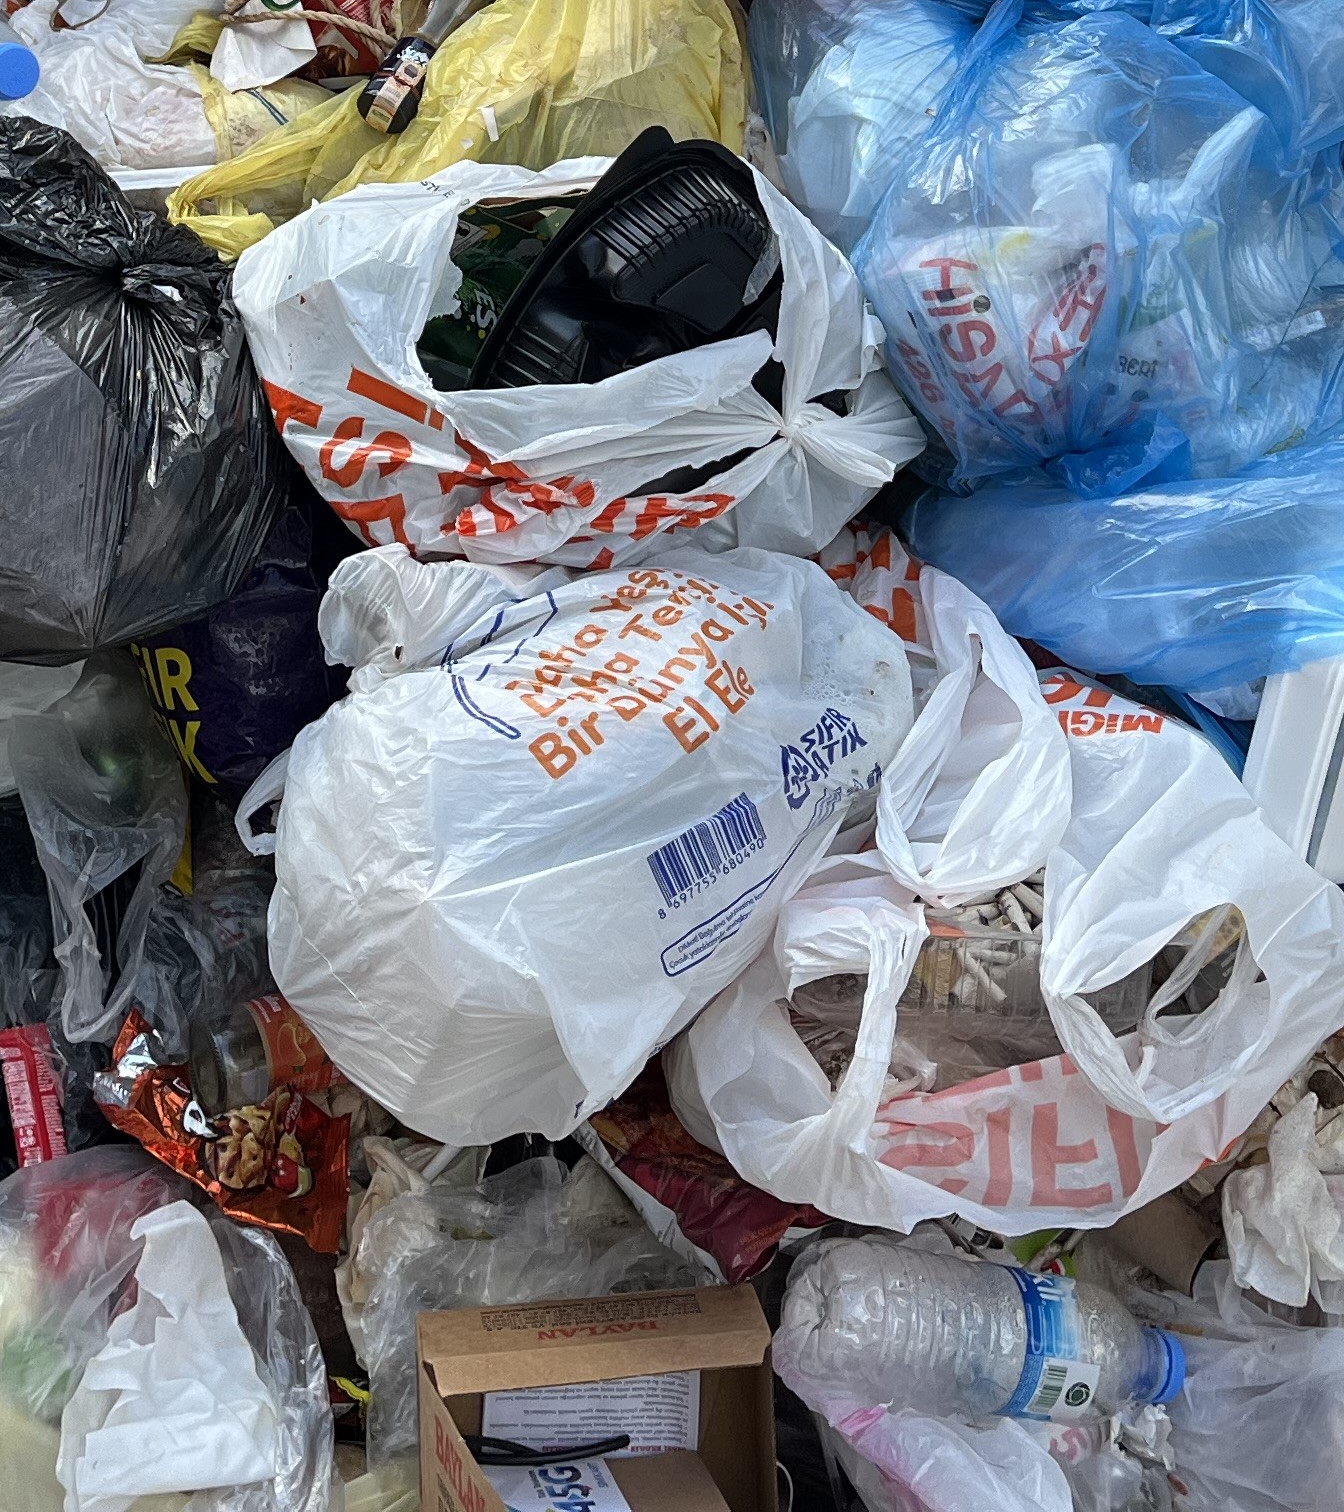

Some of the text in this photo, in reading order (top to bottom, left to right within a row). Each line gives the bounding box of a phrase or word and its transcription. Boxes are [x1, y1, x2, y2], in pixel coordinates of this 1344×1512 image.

[528, 710, 605, 780] Bir
[606, 617, 735, 723] Dünya
[661, 659, 756, 755] El Ele
[800, 706, 852, 754] SIFIR
[811, 722, 868, 779] ATIK
[658, 837, 765, 920] 8 697755 680490
[536, 1319, 660, 1342] BAYLAN
